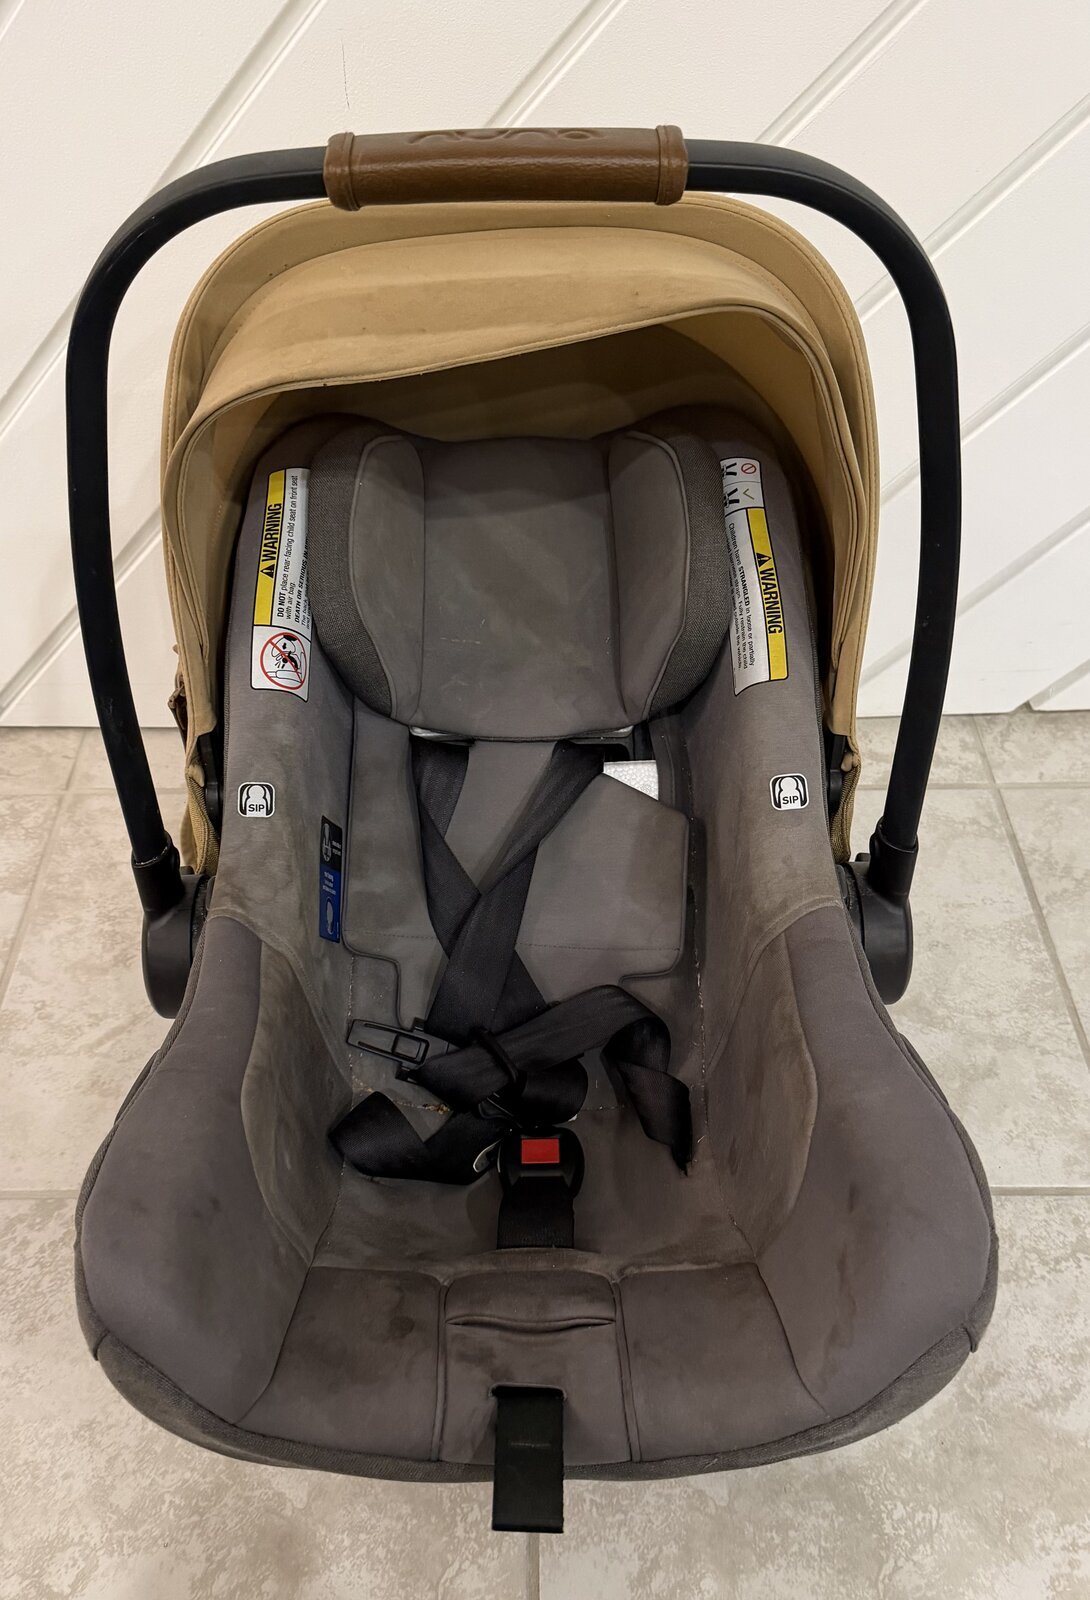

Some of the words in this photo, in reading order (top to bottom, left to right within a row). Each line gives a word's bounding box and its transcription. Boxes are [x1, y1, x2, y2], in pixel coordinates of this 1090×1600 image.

[291, 475, 299, 487] seat
[289, 487, 298, 500] front
[290, 501, 297, 510] on
[289, 509, 297, 522] seat
[261, 503, 282, 562] WARNING
[286, 522, 295, 538] child
[283, 538, 295, 572] rear-facing
[298, 559, 308, 590] SERIOUS
[728, 522, 738, 550] Children
[734, 549, 742, 566] have
[739, 565, 750, 607] STRANGLED
[747, 632, 753, 640] or
[280, 573, 289, 591] place
[278, 592, 286, 607] NOT
[297, 590, 303, 600] OR
[759, 567, 783, 634] WARNING
[277, 607, 285, 618] DO
[782, 795, 799, 805] SIP
[248, 804, 265, 812] SIP
